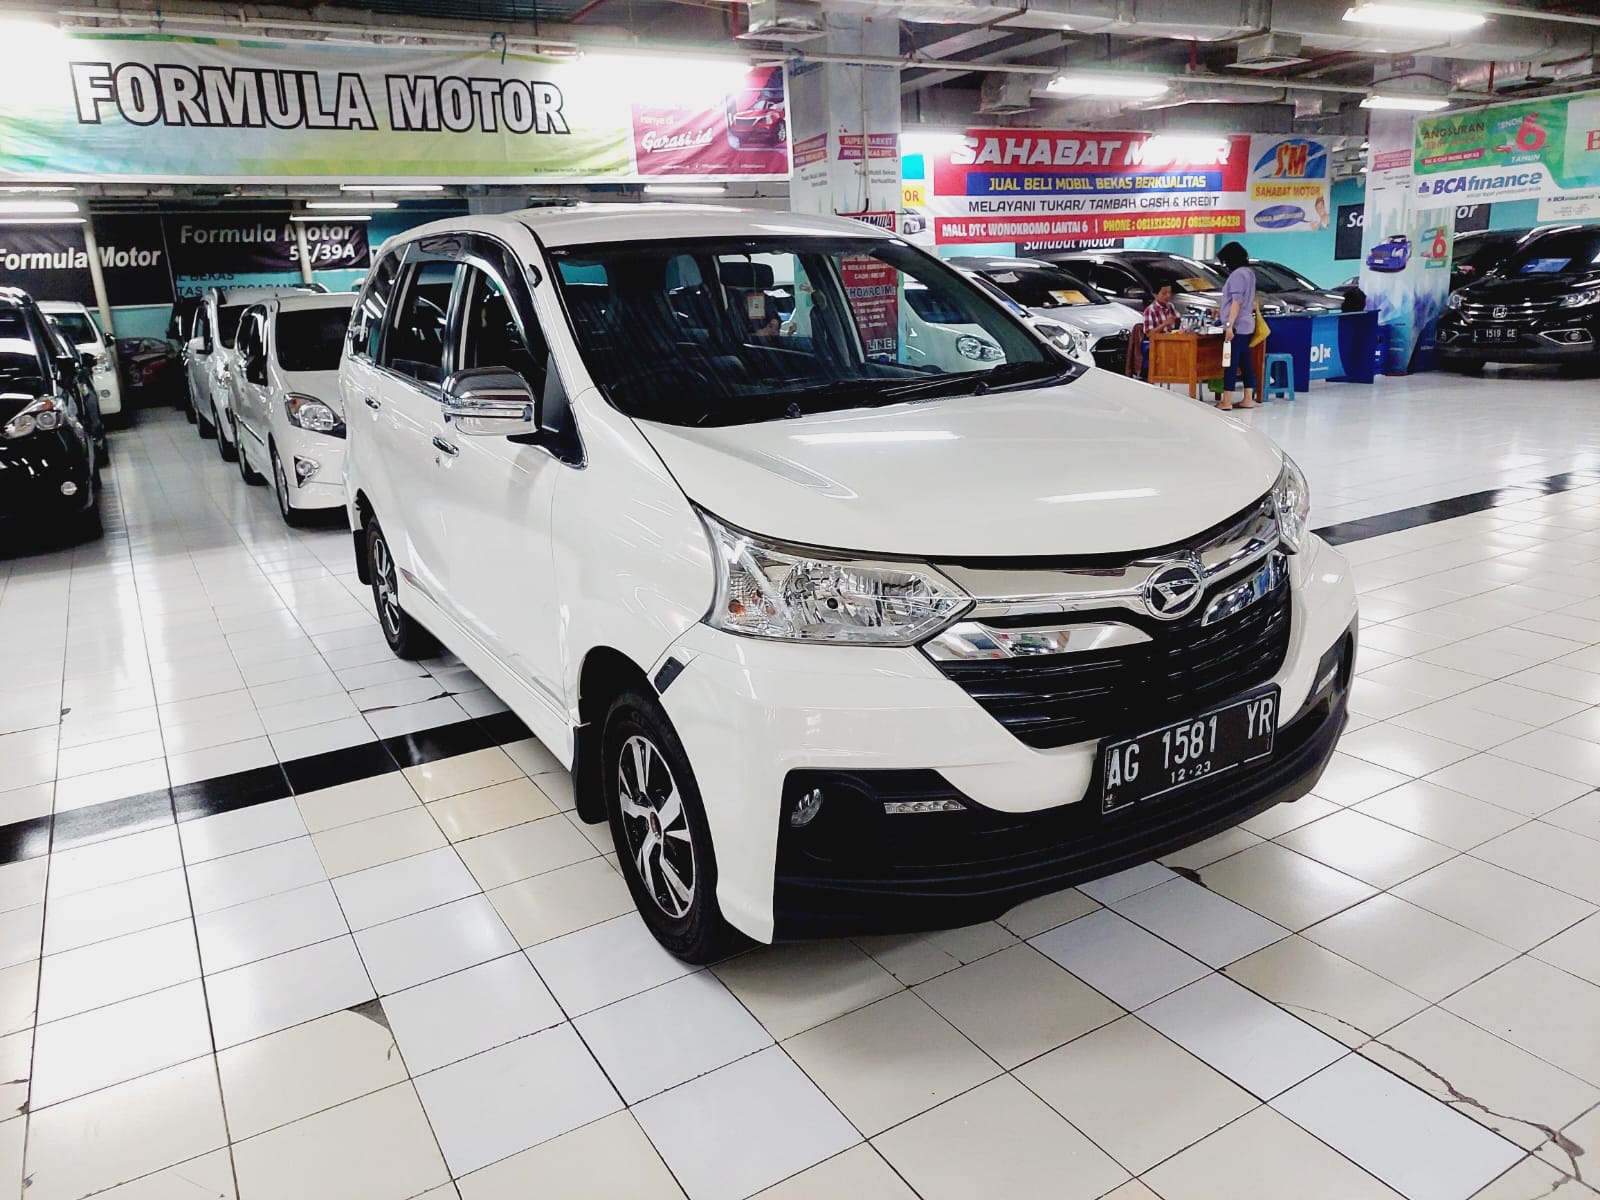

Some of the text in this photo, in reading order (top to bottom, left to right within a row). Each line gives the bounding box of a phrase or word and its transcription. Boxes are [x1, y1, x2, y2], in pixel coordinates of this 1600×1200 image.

[69, 61, 571, 135] FORMULA MOTOR
[641, 127, 713, 153] Garasi.id
[1423, 122, 1485, 140] ANGSURAN
[1516, 112, 1547, 152] 6
[950, 136, 1119, 166] SAHABAT
[988, 175, 1207, 191] JUAL BELI MOBIL BEKAS BERKUALITAS
[1255, 185, 1321, 197] SAHABAT MOTOR
[968, 200, 1036, 213] MELAYANI
[1089, 198, 1136, 211] TAMBAH
[1139, 197, 1170, 208] CASH
[1172, 199, 1180, 208] &
[1183, 196, 1220, 207] KREDIT
[180, 223, 353, 244] Formula Motor
[942, 220, 1089, 237] MALL DTC WONOKROMO LANTAI 6
[1103, 218, 1131, 232] PHONE
[0, 246, 162, 271] Formula Motor
[1107, 698, 1273, 790] AG 1581 YR
